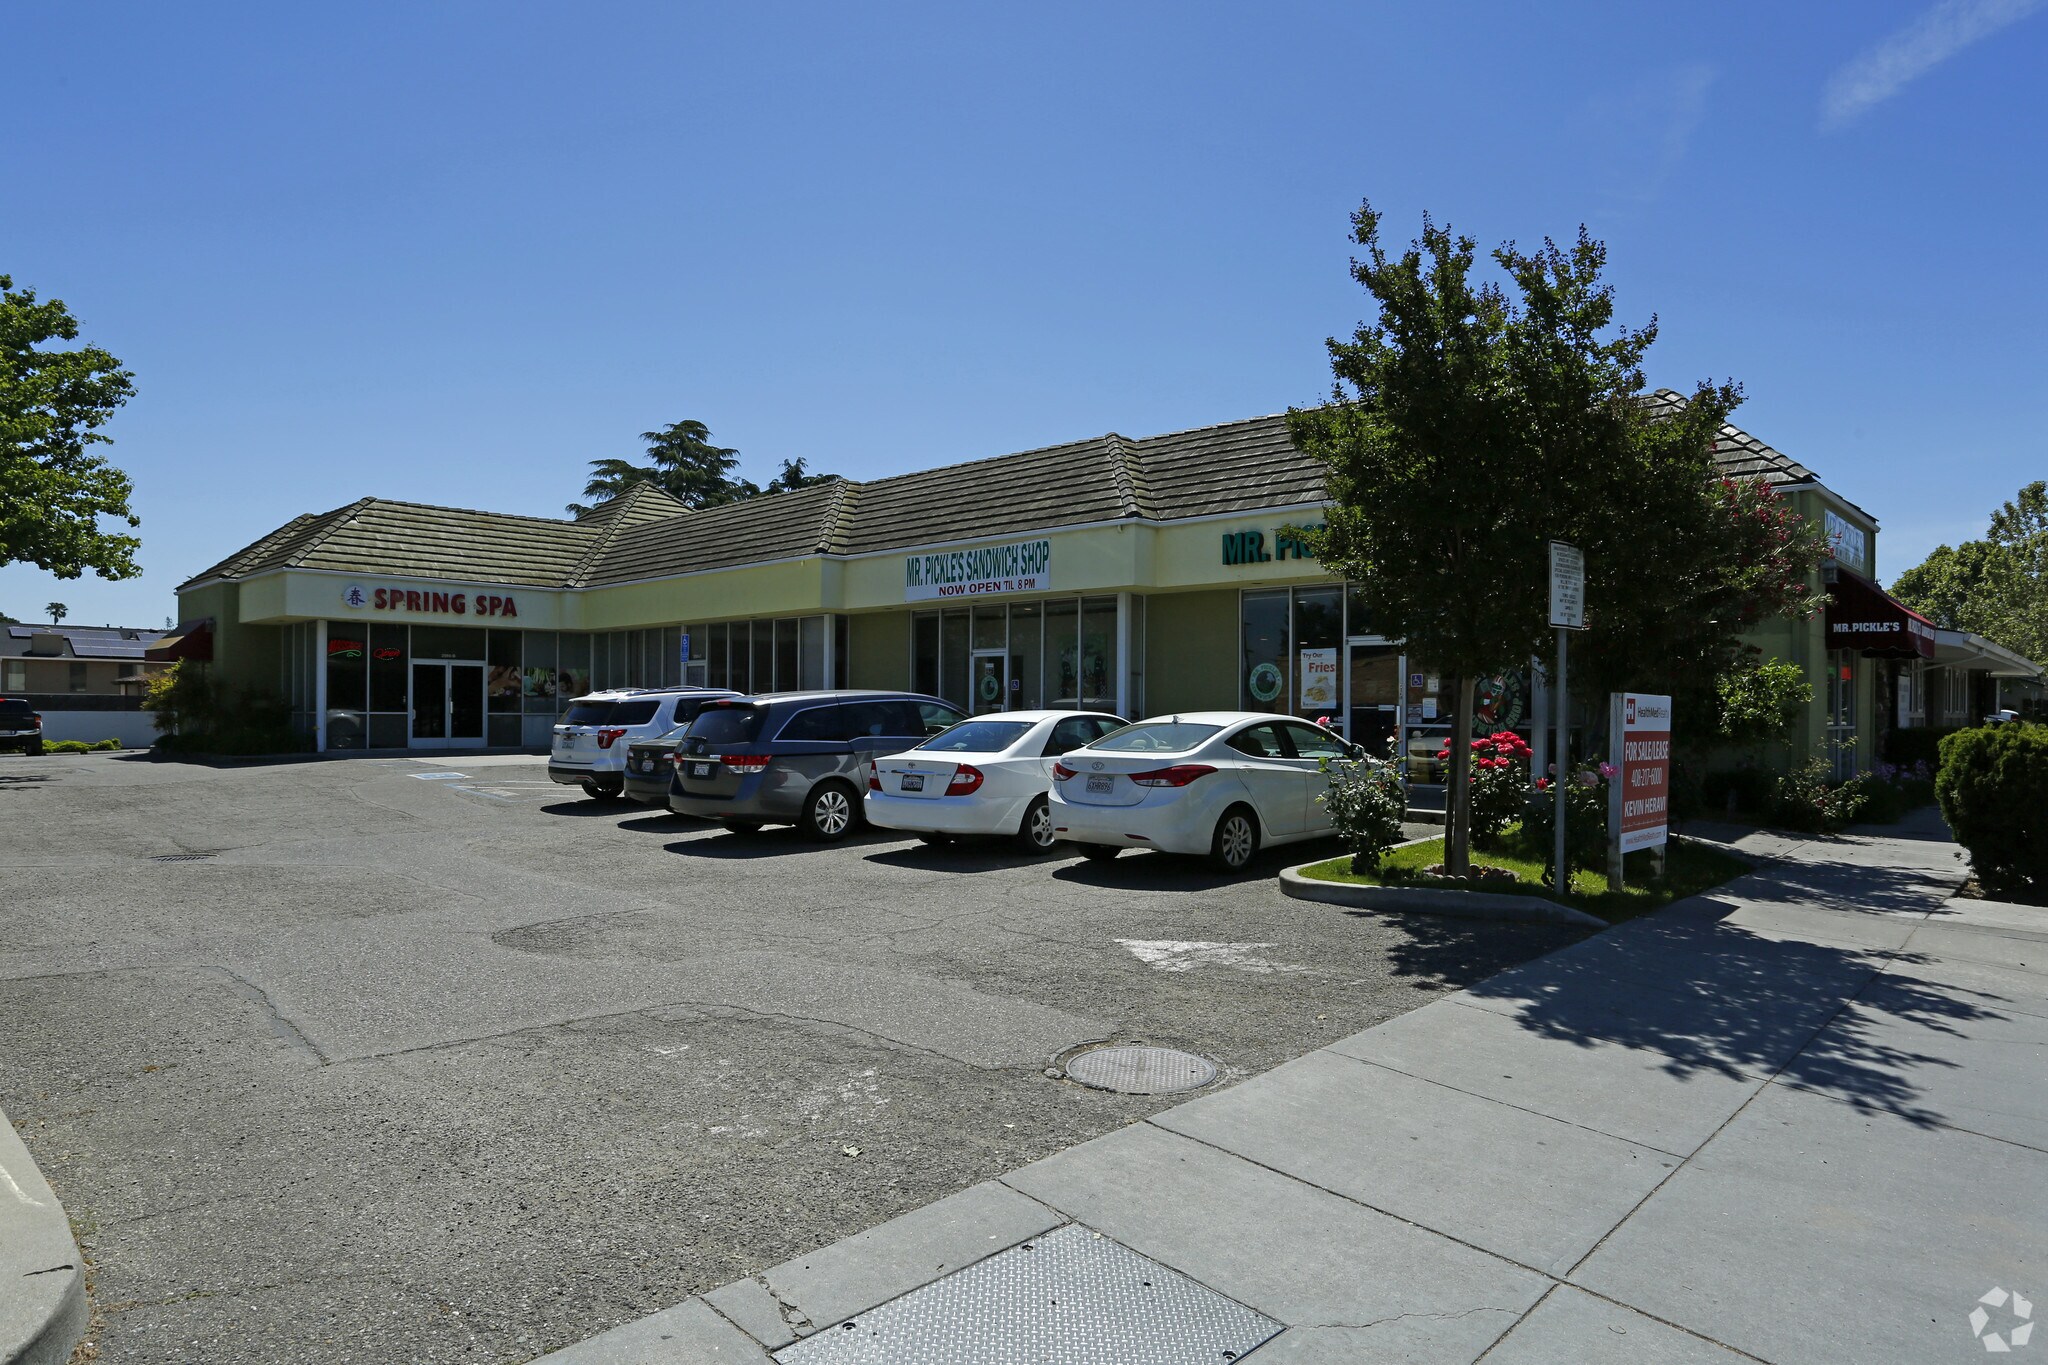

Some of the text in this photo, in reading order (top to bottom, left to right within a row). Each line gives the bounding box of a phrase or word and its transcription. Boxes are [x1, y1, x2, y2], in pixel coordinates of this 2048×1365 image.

[1222, 531, 1271, 565] MR.
[906, 540, 1050, 587] MR. PICKLE'S SANDWICH SHOP
[347, 587, 366, 606] 春
[938, 585, 966, 596] NOW
[969, 581, 1001, 593] OPEN
[1017, 579, 1023, 590] 8
[1024, 578, 1036, 589] PM
[374, 588, 518, 617] SPRING SPA
[1308, 662, 1336, 673] Fries
[1505, 698, 1523, 728] SHOP
[1625, 740, 1669, 761] FOR SALE/LEASE
[1624, 796, 1667, 817] KEVIN HERAVI
